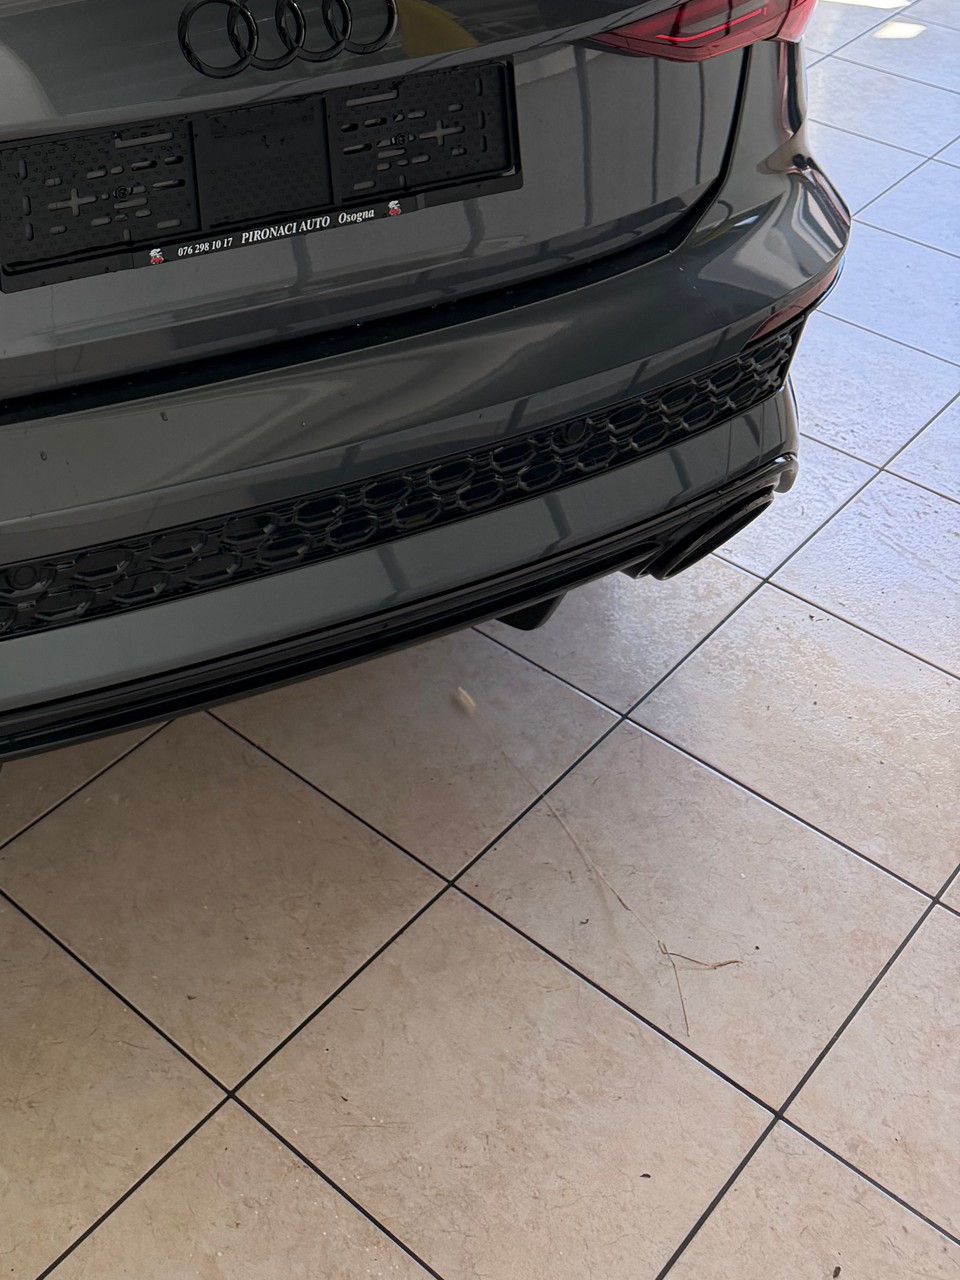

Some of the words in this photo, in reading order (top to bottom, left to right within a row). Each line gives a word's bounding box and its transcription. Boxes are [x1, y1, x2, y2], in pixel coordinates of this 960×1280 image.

[177, 245, 193, 257] 076
[195, 242, 210, 254] 298
[212, 239, 222, 251] 10
[223, 237, 233, 248] 17
[241, 223, 297, 244] PIRONACI
[299, 216, 331, 232] AUTO
[338, 209, 375, 224] Osogna
